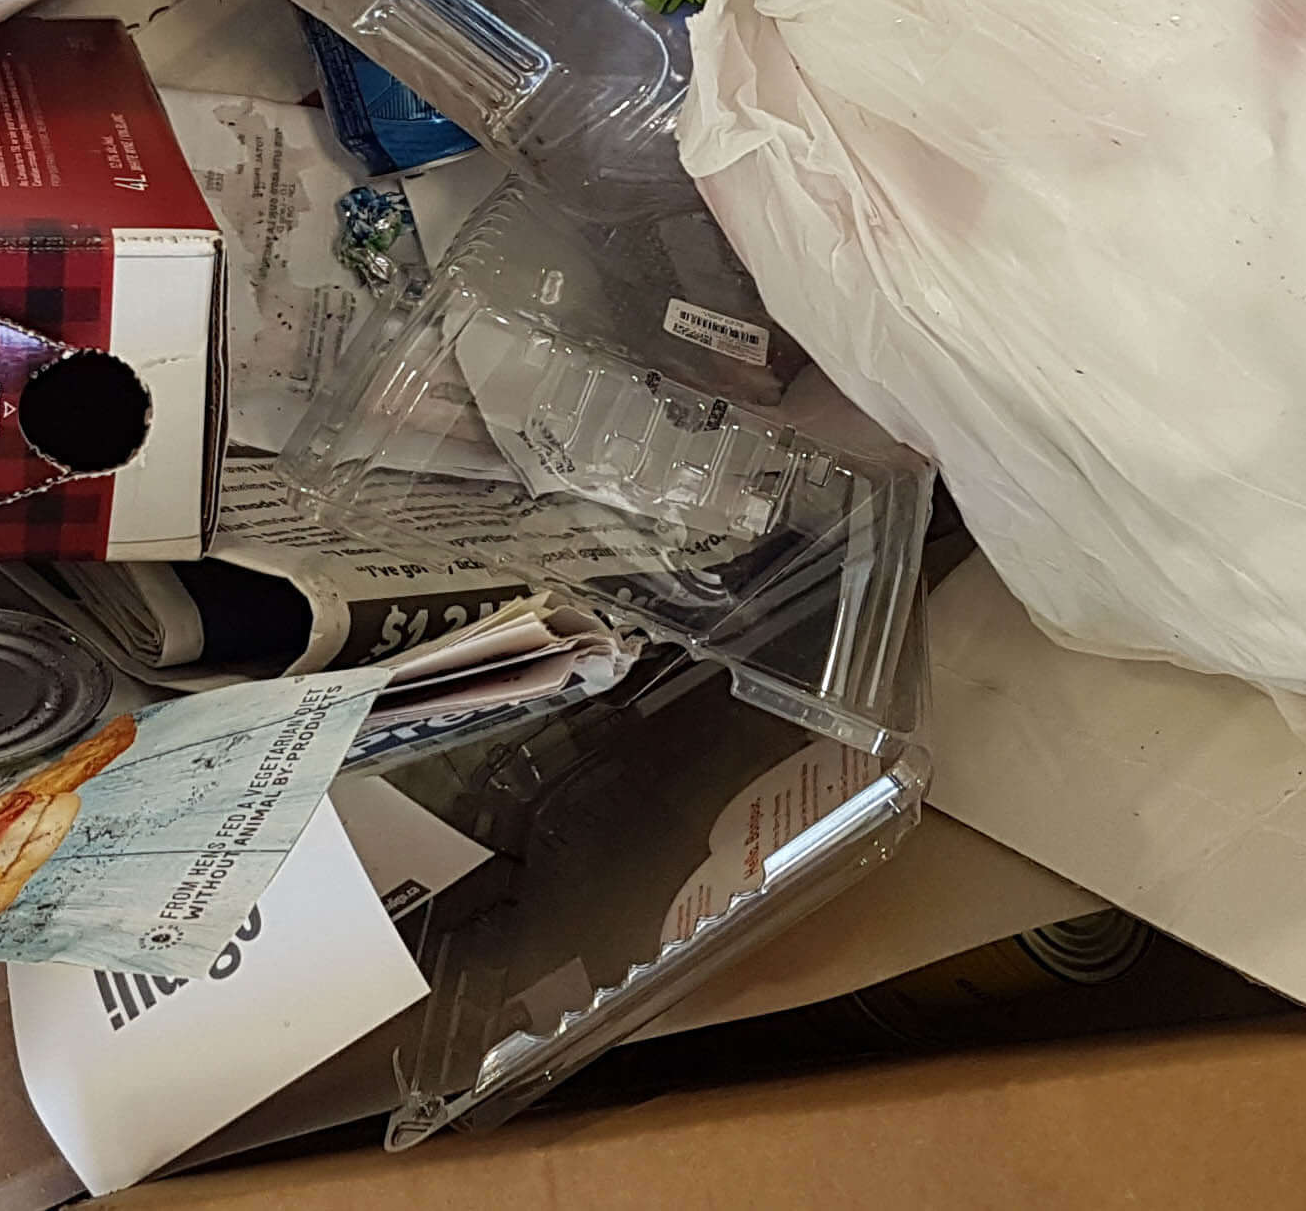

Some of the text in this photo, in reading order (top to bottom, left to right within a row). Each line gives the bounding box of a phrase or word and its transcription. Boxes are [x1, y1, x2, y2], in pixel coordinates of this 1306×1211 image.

[113, 173, 149, 191] 4L
[159, 687, 325, 920] FROM HENS FED VEGETARIAN DIET
[182, 684, 343, 921] WITHOUT ANIMAL BY-PRODUCTS
